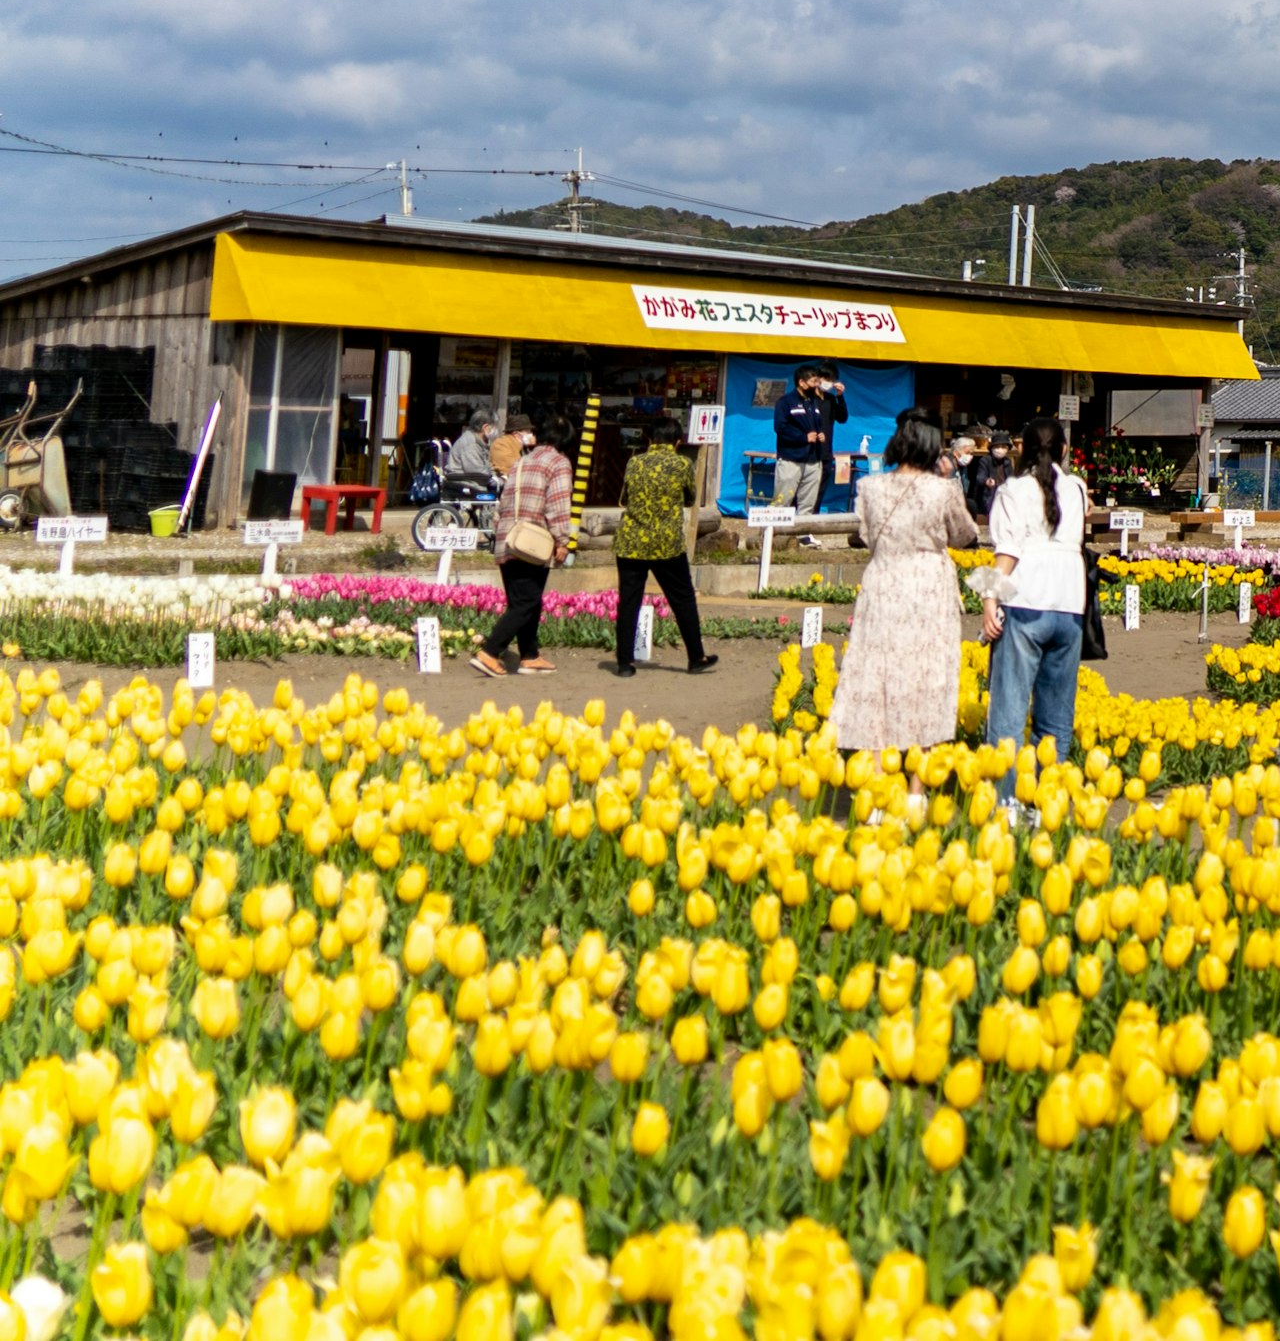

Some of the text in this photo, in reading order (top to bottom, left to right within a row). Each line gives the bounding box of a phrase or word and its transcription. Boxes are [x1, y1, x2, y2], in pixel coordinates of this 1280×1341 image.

[642, 294, 896, 332] かがみ花フェスタチューリップまつり
